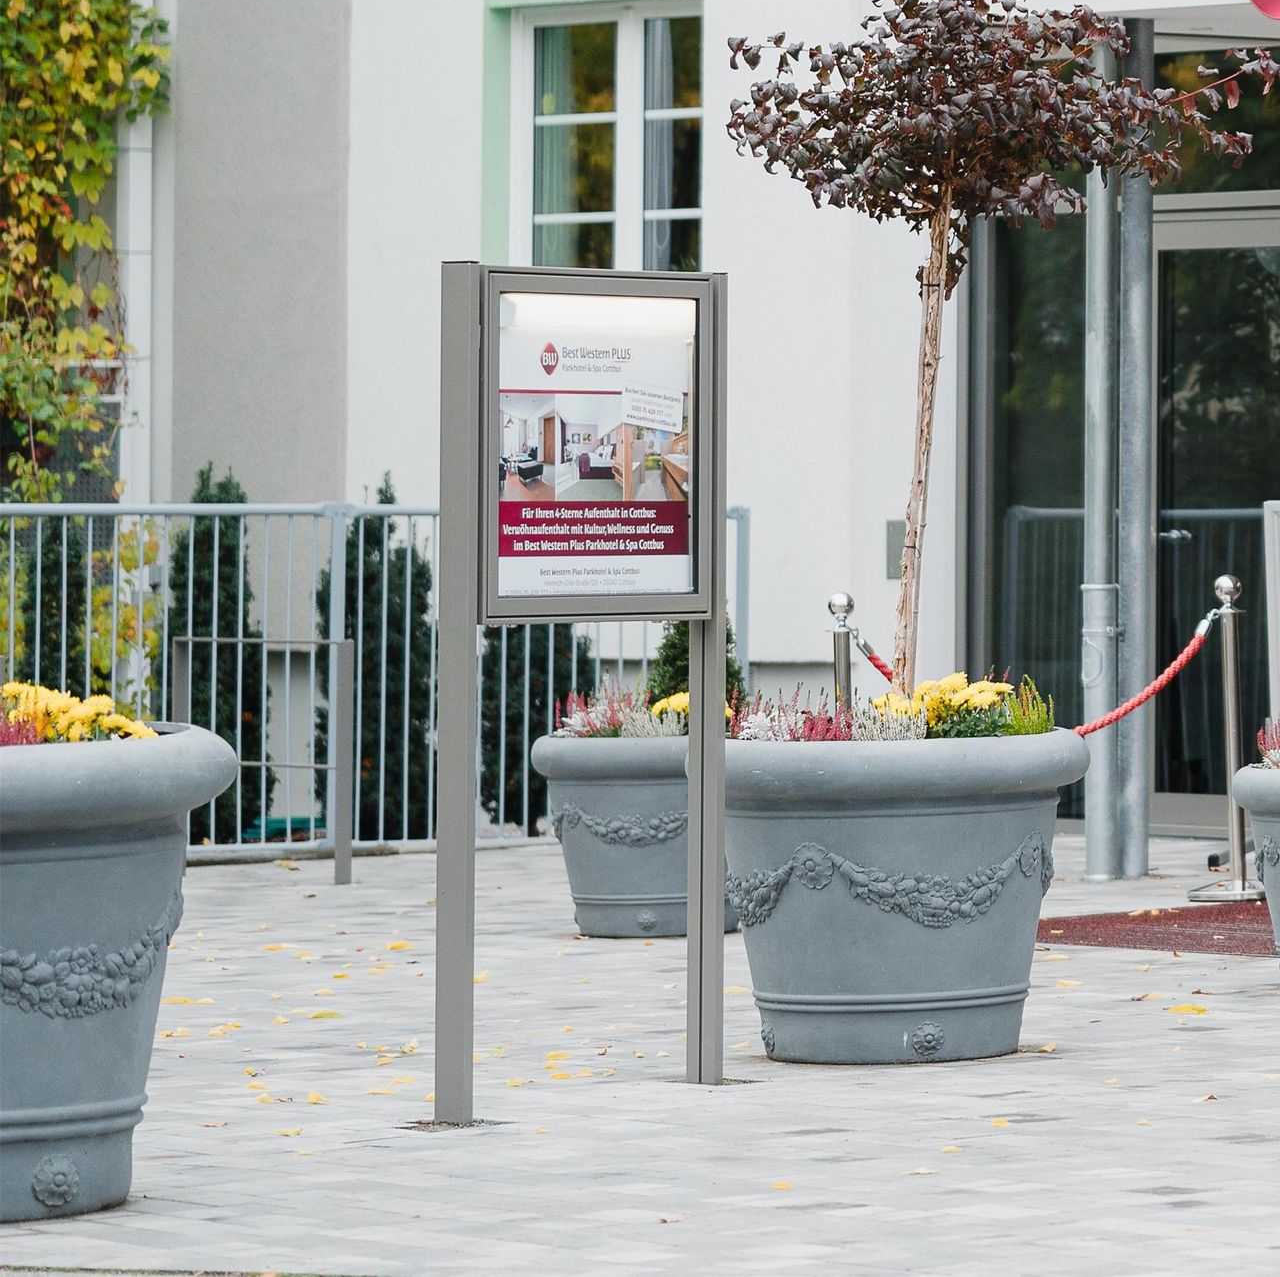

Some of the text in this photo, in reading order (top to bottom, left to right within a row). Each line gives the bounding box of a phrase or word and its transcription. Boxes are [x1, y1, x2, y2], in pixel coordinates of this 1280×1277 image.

[542, 352, 557, 366] BW
[562, 346, 631, 360] Best Western PLUS
[522, 507, 657, 519] Für Ihren 4-Sterne Aufenthalt in Cottbus:
[503, 523, 674, 536] Verwöhnaufenthalt mit Kultur, Wellness und Genuss
[513, 538, 665, 552] im Best Western Plus Parkhotel & Spa Cottbus
